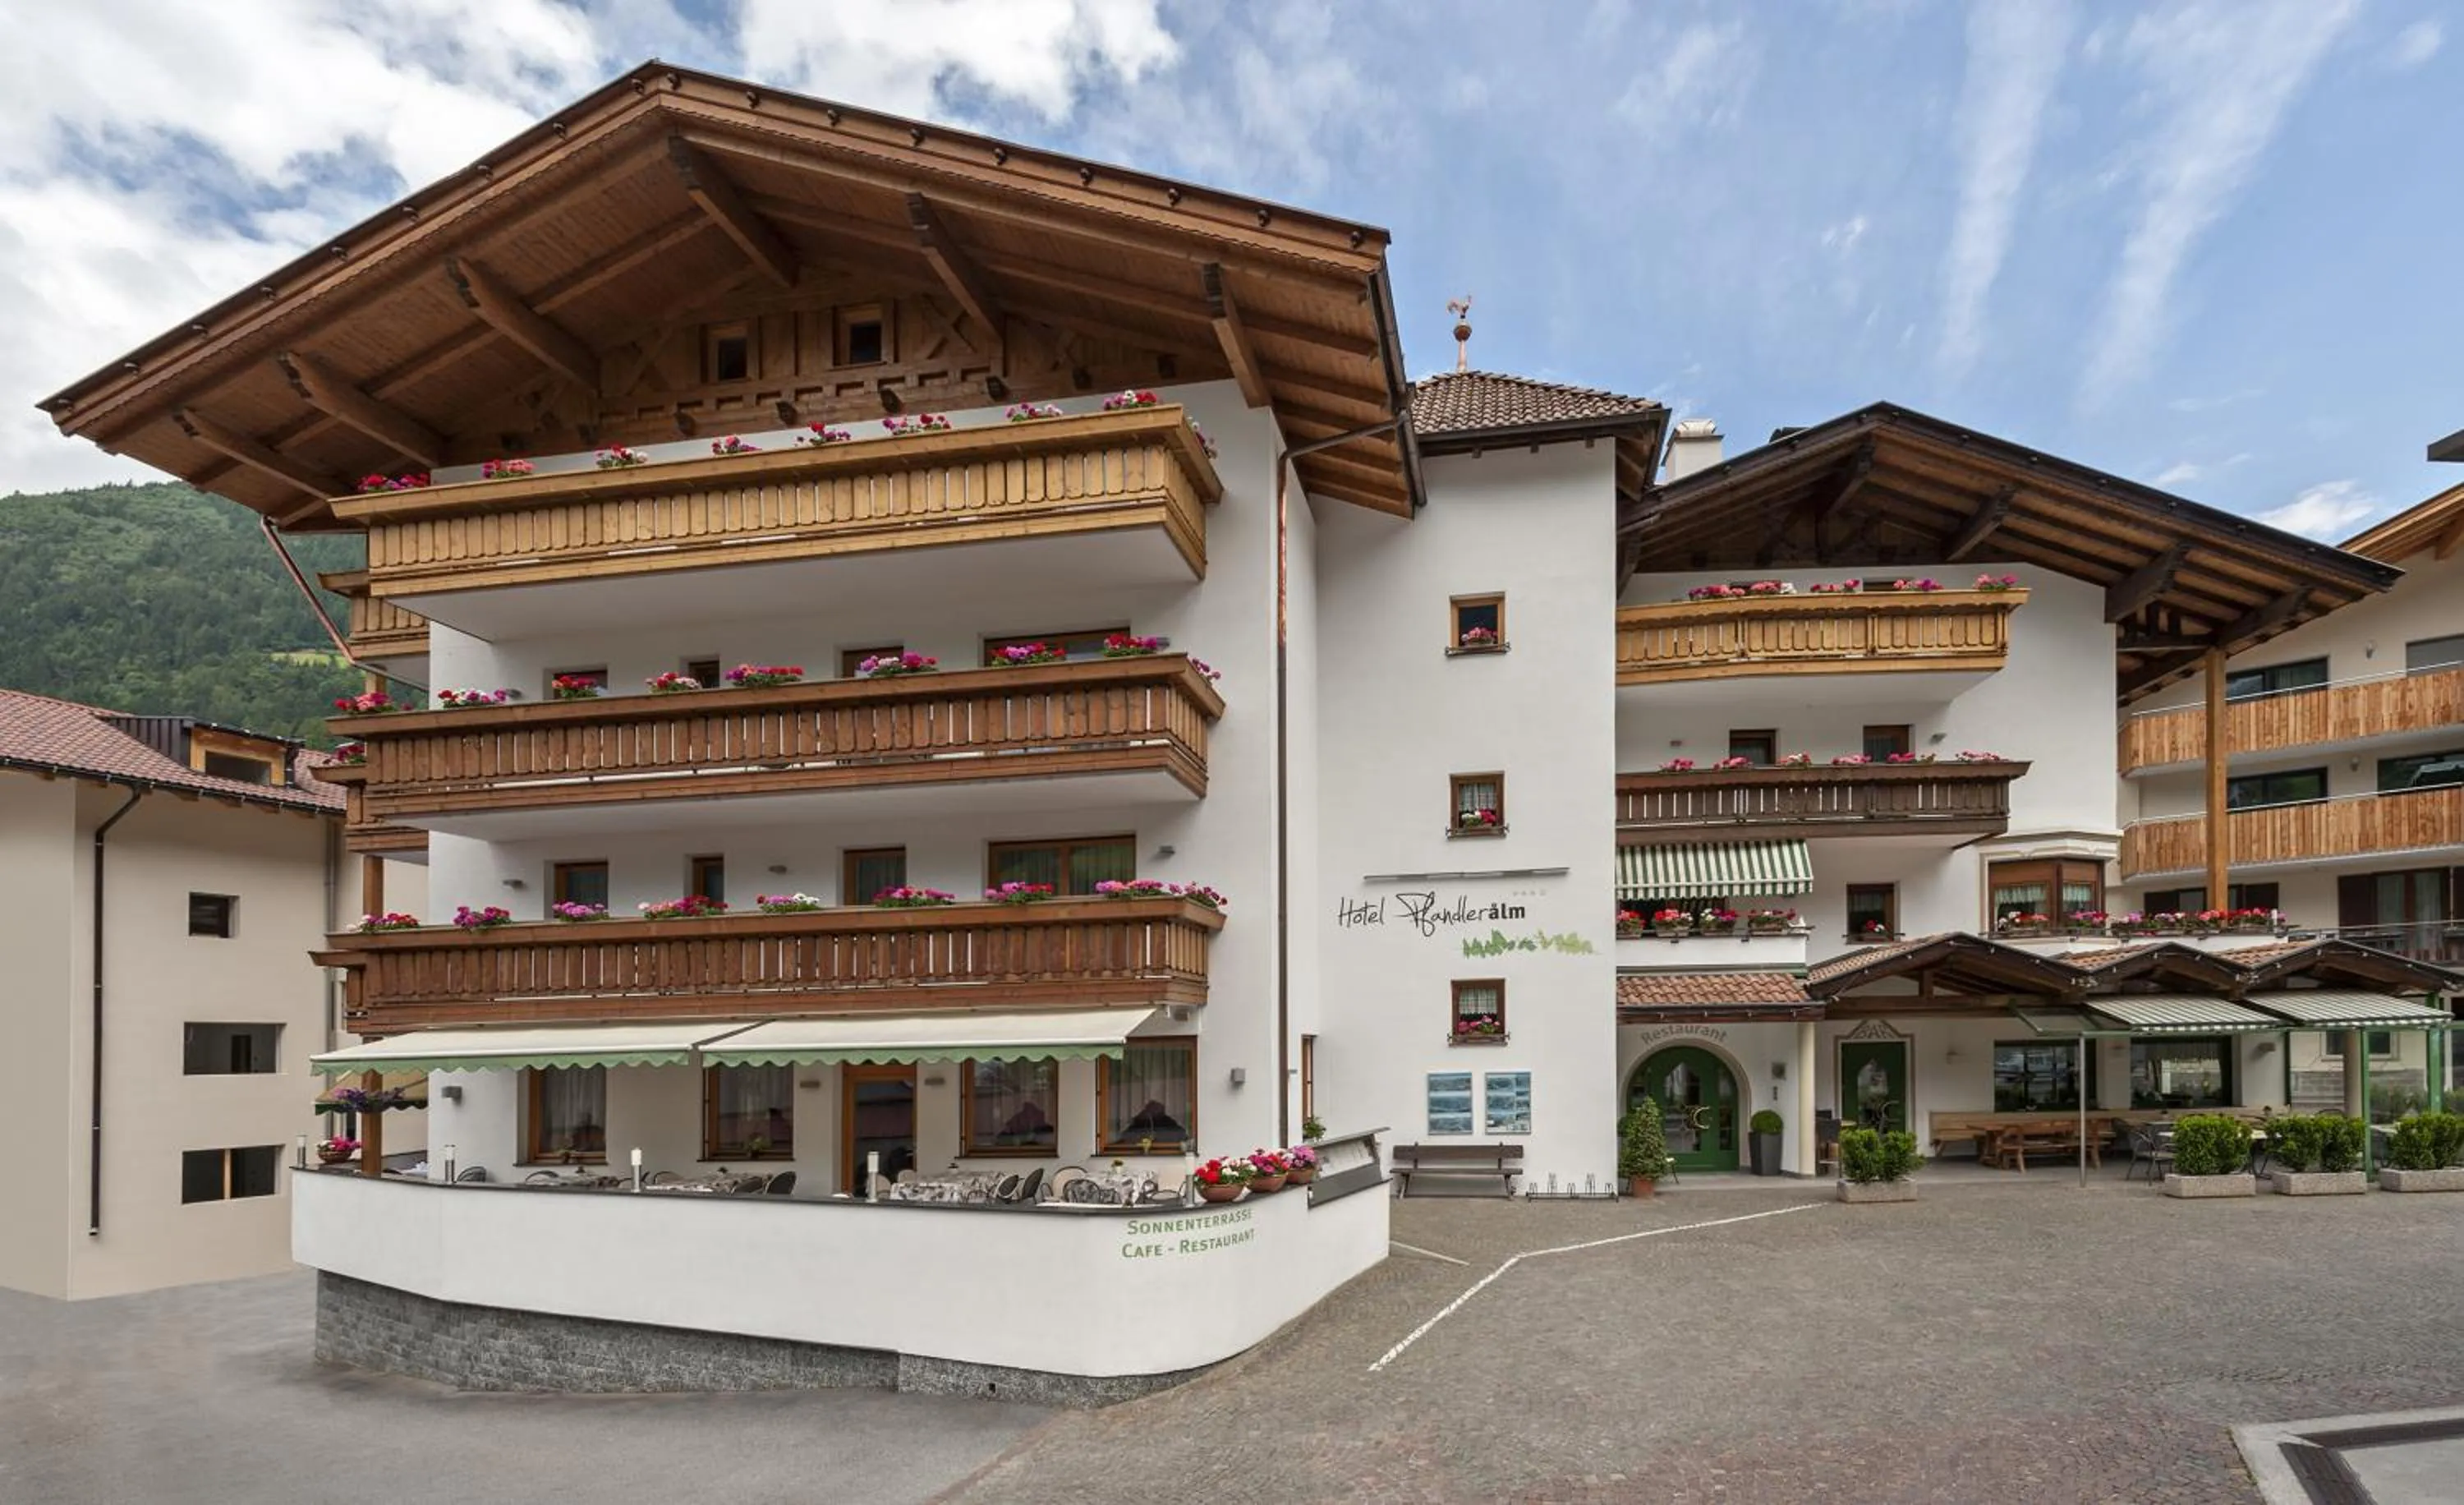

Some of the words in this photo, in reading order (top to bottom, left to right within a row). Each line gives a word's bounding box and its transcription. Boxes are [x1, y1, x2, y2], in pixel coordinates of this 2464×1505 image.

[1338, 896, 1385, 927] Hotel
[1640, 1024, 1727, 1045] Restaurant
[1853, 1024, 1895, 1039] BAR
[1122, 1243, 1163, 1258] CAFE
[1179, 1228, 1255, 1254] RESTAURANT
